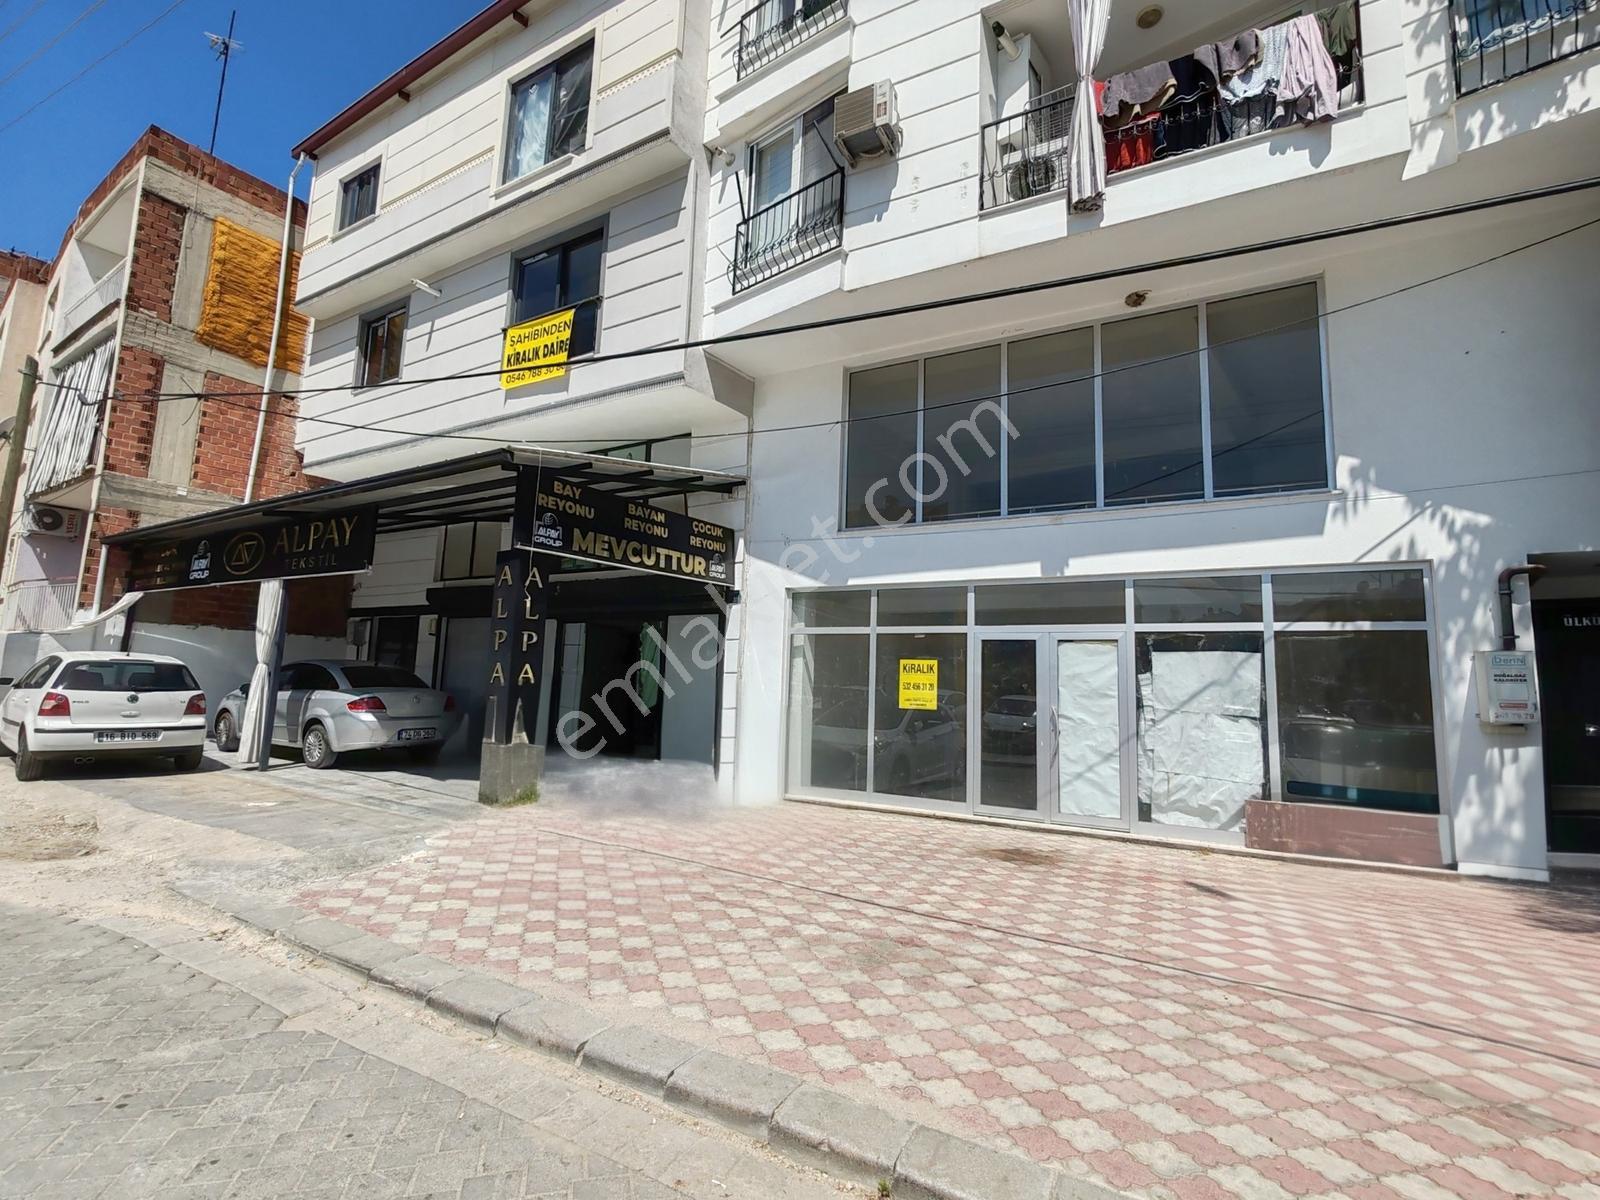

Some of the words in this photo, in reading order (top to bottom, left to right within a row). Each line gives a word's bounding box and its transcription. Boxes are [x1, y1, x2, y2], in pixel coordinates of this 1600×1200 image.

[506, 347, 541, 369] KİRALIK
[542, 336, 569, 358] DAİRE
[505, 373, 526, 384] 0546
[553, 481, 582, 499] BAY
[537, 493, 595, 519] REYONU
[628, 503, 666, 523] BAYAN
[272, 515, 358, 556] ALPAY
[538, 526, 560, 539] ALPAY
[624, 518, 669, 538] REYONU
[692, 521, 724, 538] ÇOCUK
[534, 535, 563, 547] GROUP
[690, 535, 727, 553] REYONU
[572, 527, 707, 576] MEVCUTTUR
[104, 733, 116, 741] 16
